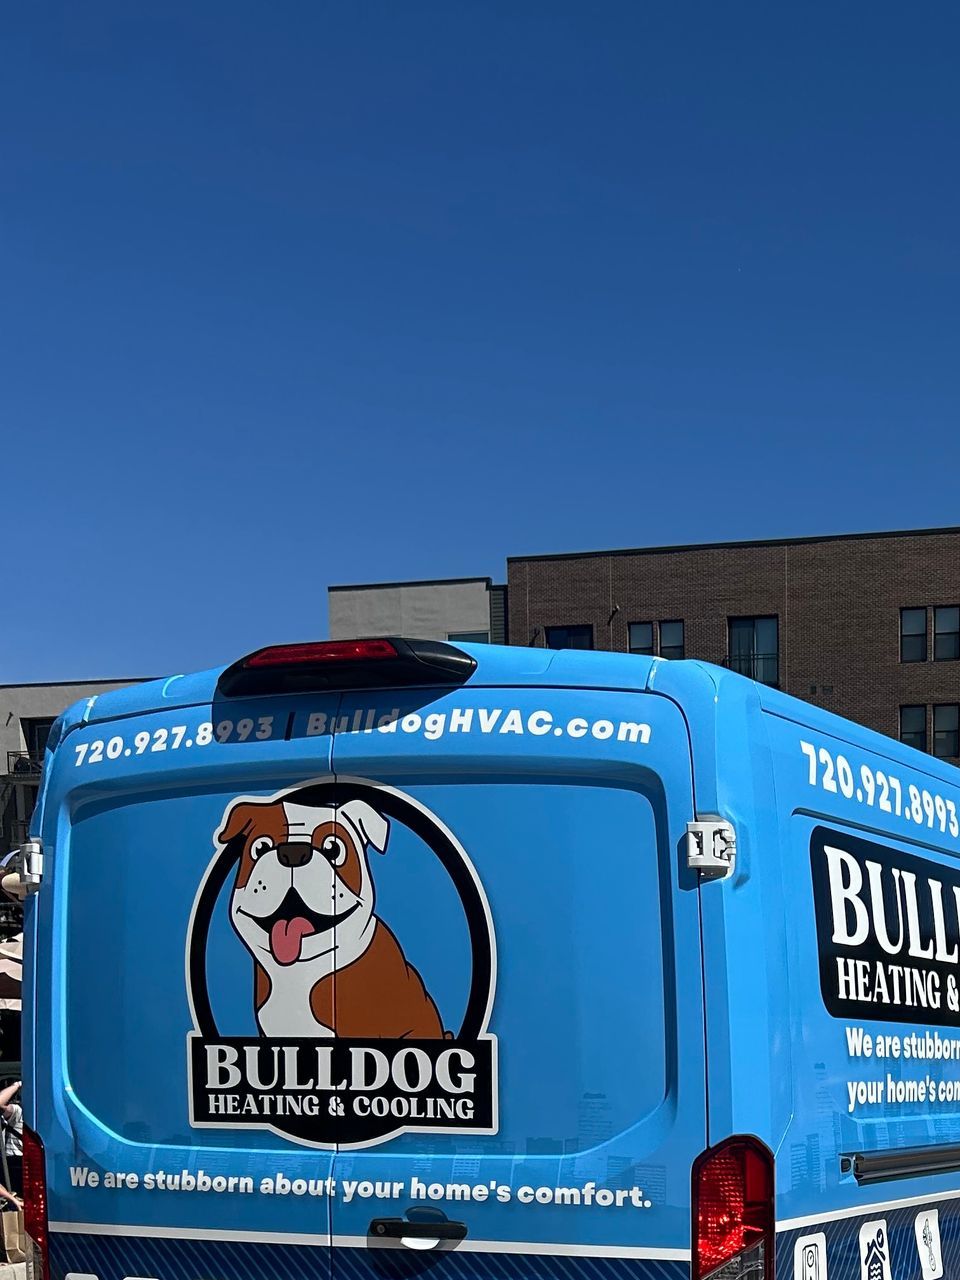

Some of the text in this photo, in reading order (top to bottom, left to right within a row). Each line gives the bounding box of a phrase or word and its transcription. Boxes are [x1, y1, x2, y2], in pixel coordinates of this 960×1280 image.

[75, 716, 274, 767] 720.927.8993
[306, 707, 652, 745] BulldogHVAC.com
[800, 740, 960, 838] 720.927.8993
[836, 956, 941, 1009] HEATING
[946, 974, 960, 1013] &
[845, 1027, 873, 1058] We
[876, 1034, 901, 1059] are
[204, 1044, 477, 1094] BULLDOG
[208, 1094, 475, 1120] HEATING & COOLING
[847, 1080, 884, 1112] your
[887, 1073, 936, 1103] home's
[69, 1166, 652, 1209] We are stubborn about your home's comfort.
